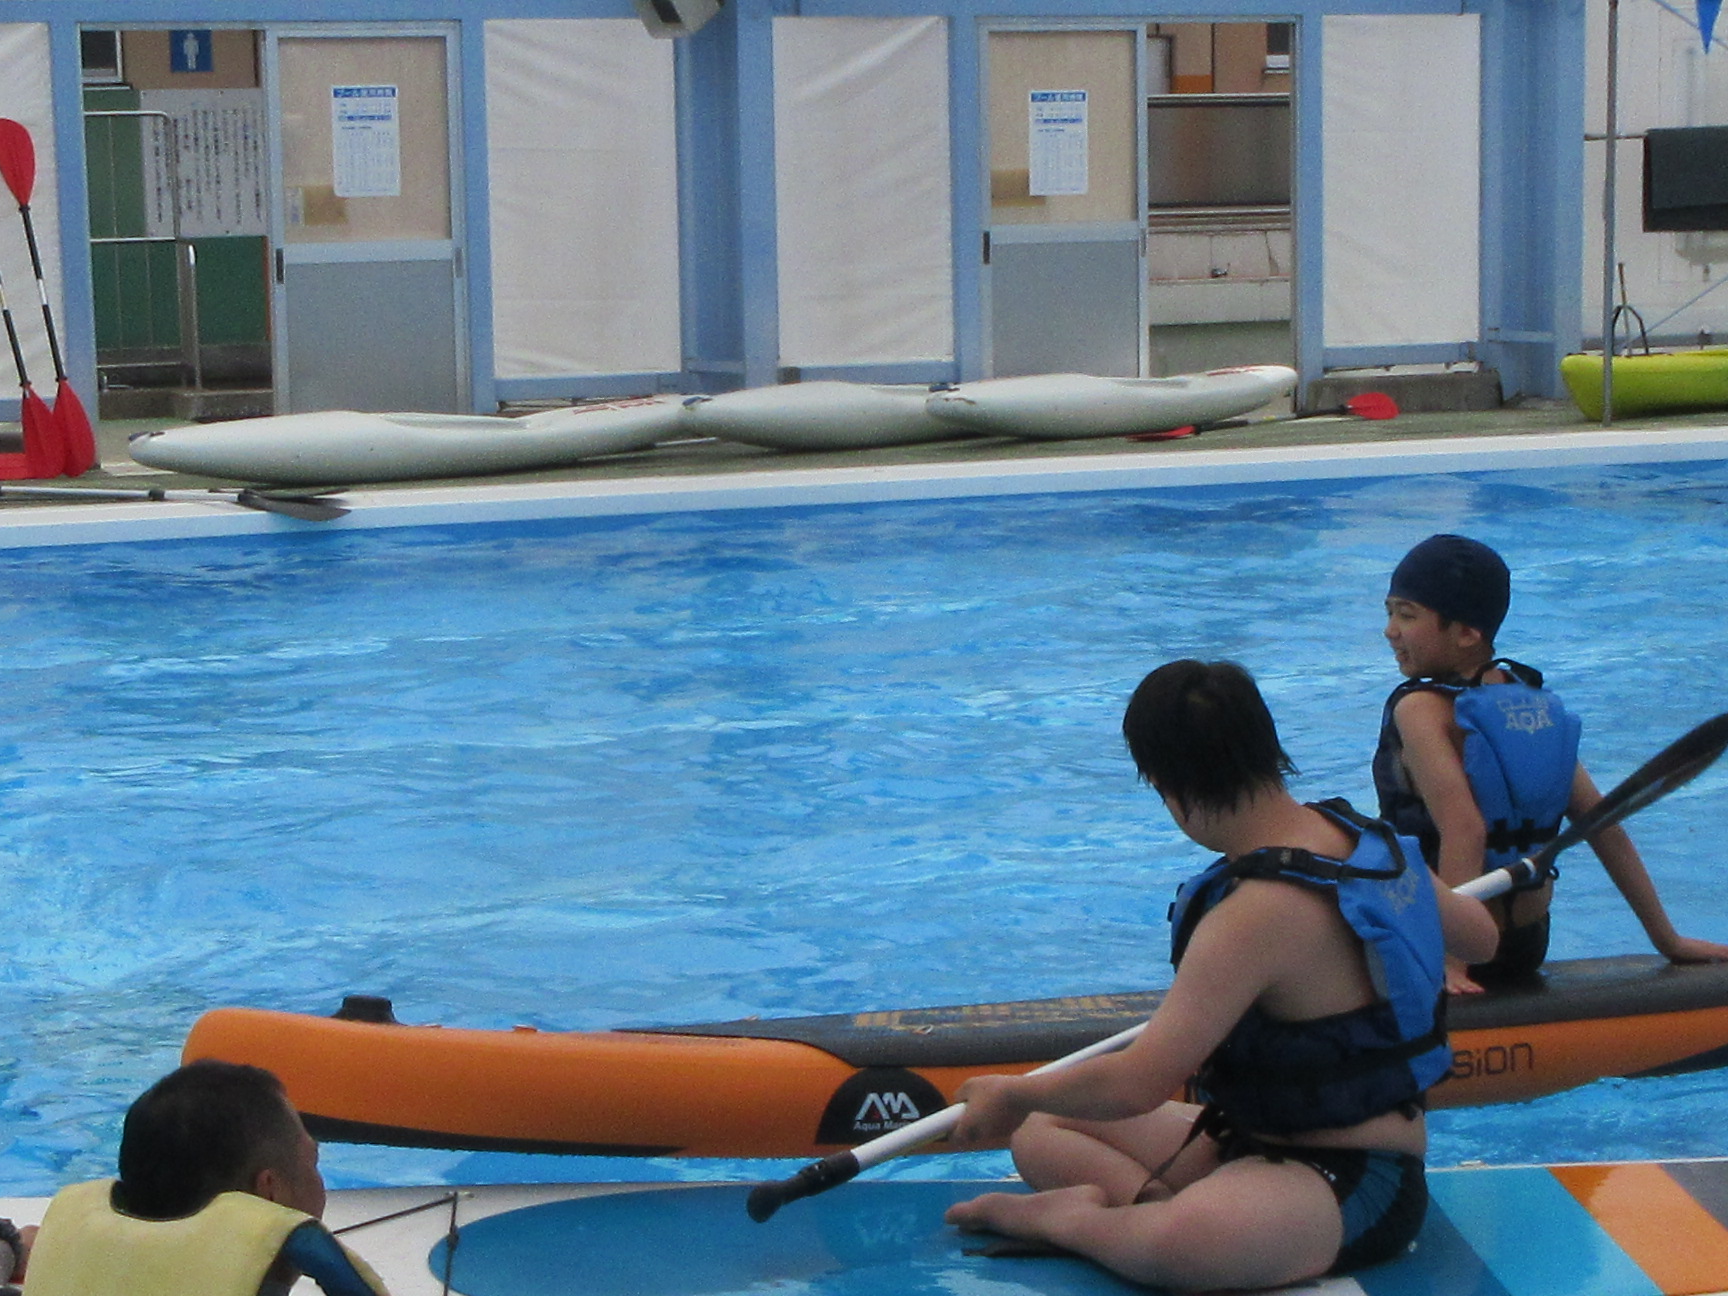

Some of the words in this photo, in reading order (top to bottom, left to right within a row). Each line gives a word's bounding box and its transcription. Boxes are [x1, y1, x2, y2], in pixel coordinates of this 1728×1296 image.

[1506, 710, 1552, 734] AQA
[1452, 1043, 1534, 1079] sion
[853, 1121, 881, 1132] Aqua
